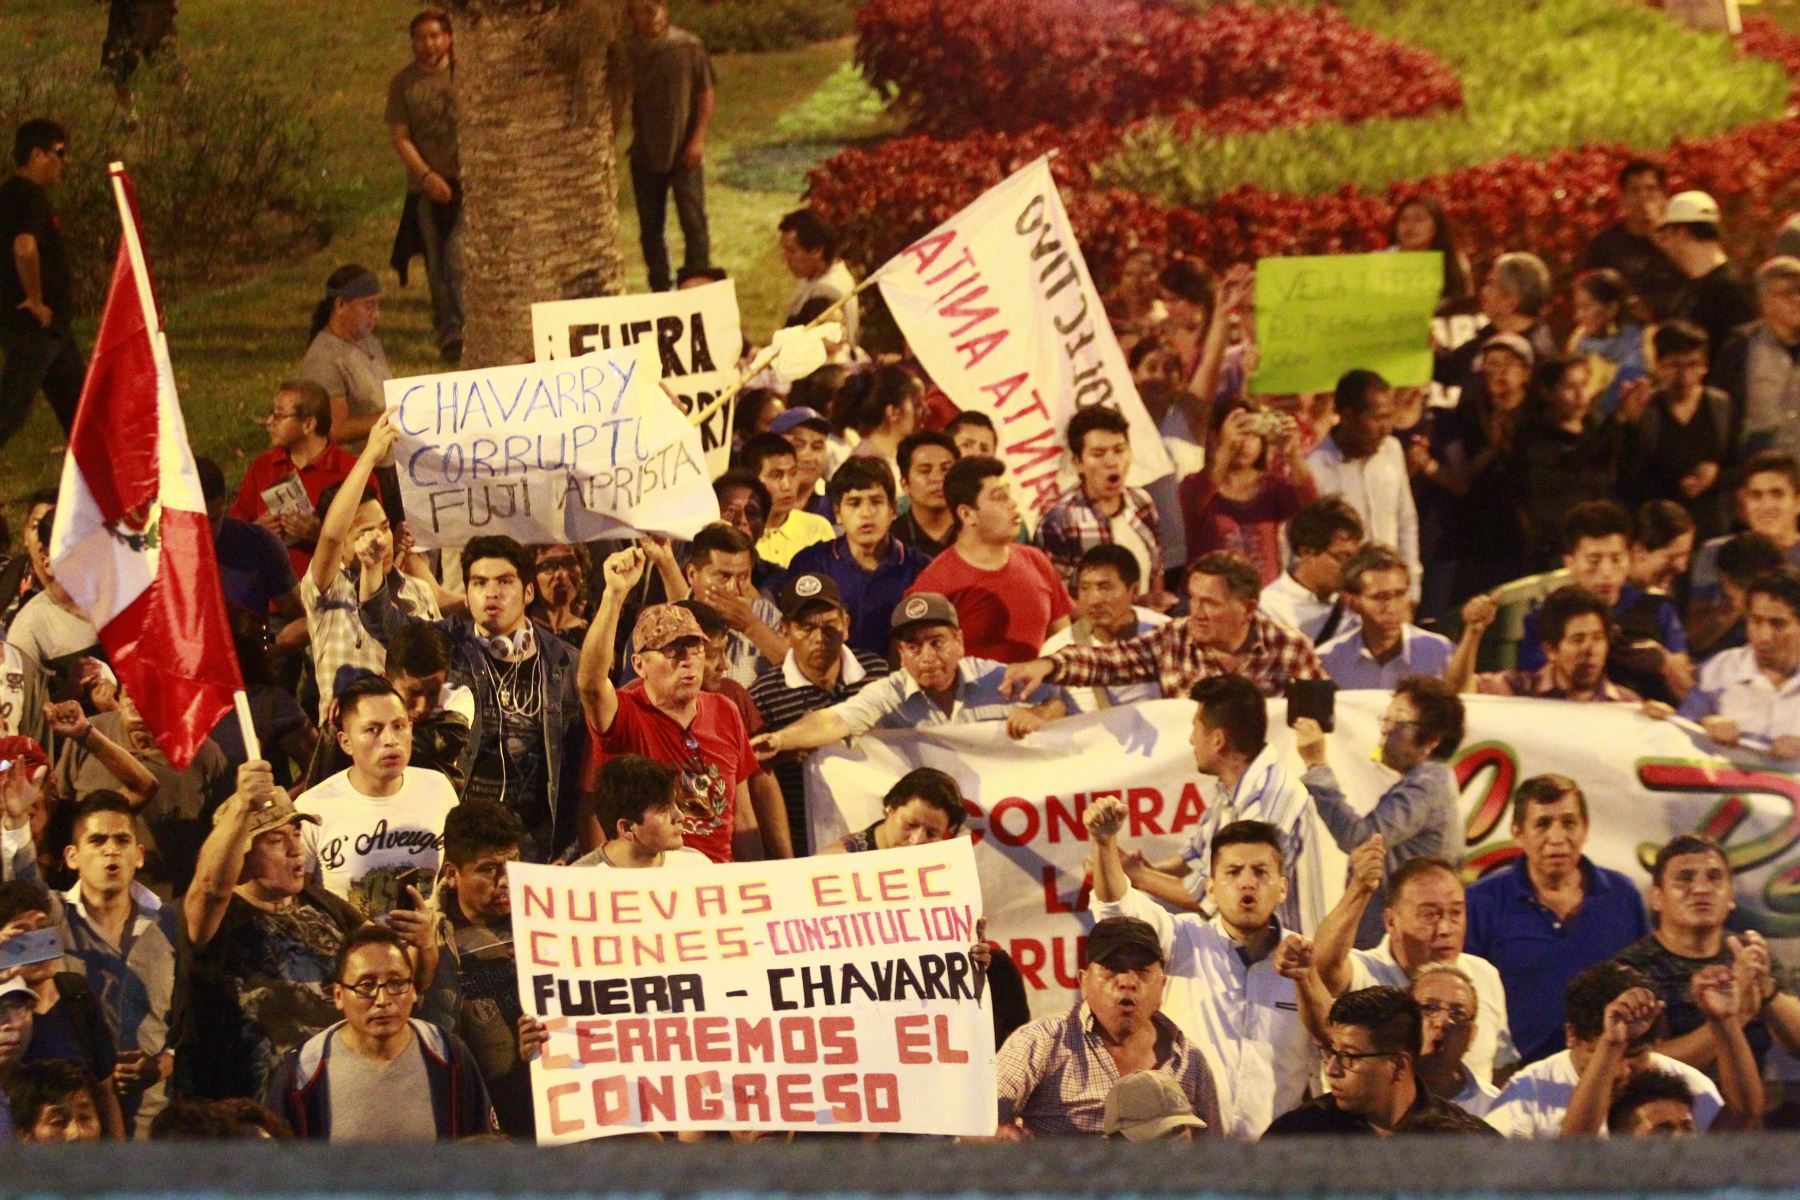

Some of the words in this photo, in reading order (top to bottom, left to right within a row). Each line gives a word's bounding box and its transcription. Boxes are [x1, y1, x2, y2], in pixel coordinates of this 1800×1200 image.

[400, 359, 636, 436] CHAVARRY
[557, 440, 701, 511] APRISTA
[945, 783, 1207, 847] CONRA
[524, 882, 772, 924] NUEVAS
[812, 864, 951, 908] ELEC
[533, 973, 706, 1016] FUERA
[541, 1015, 859, 1071] CERREMOS
[895, 1014, 970, 1065] EL
[547, 1070, 902, 1137] CONGRESO
